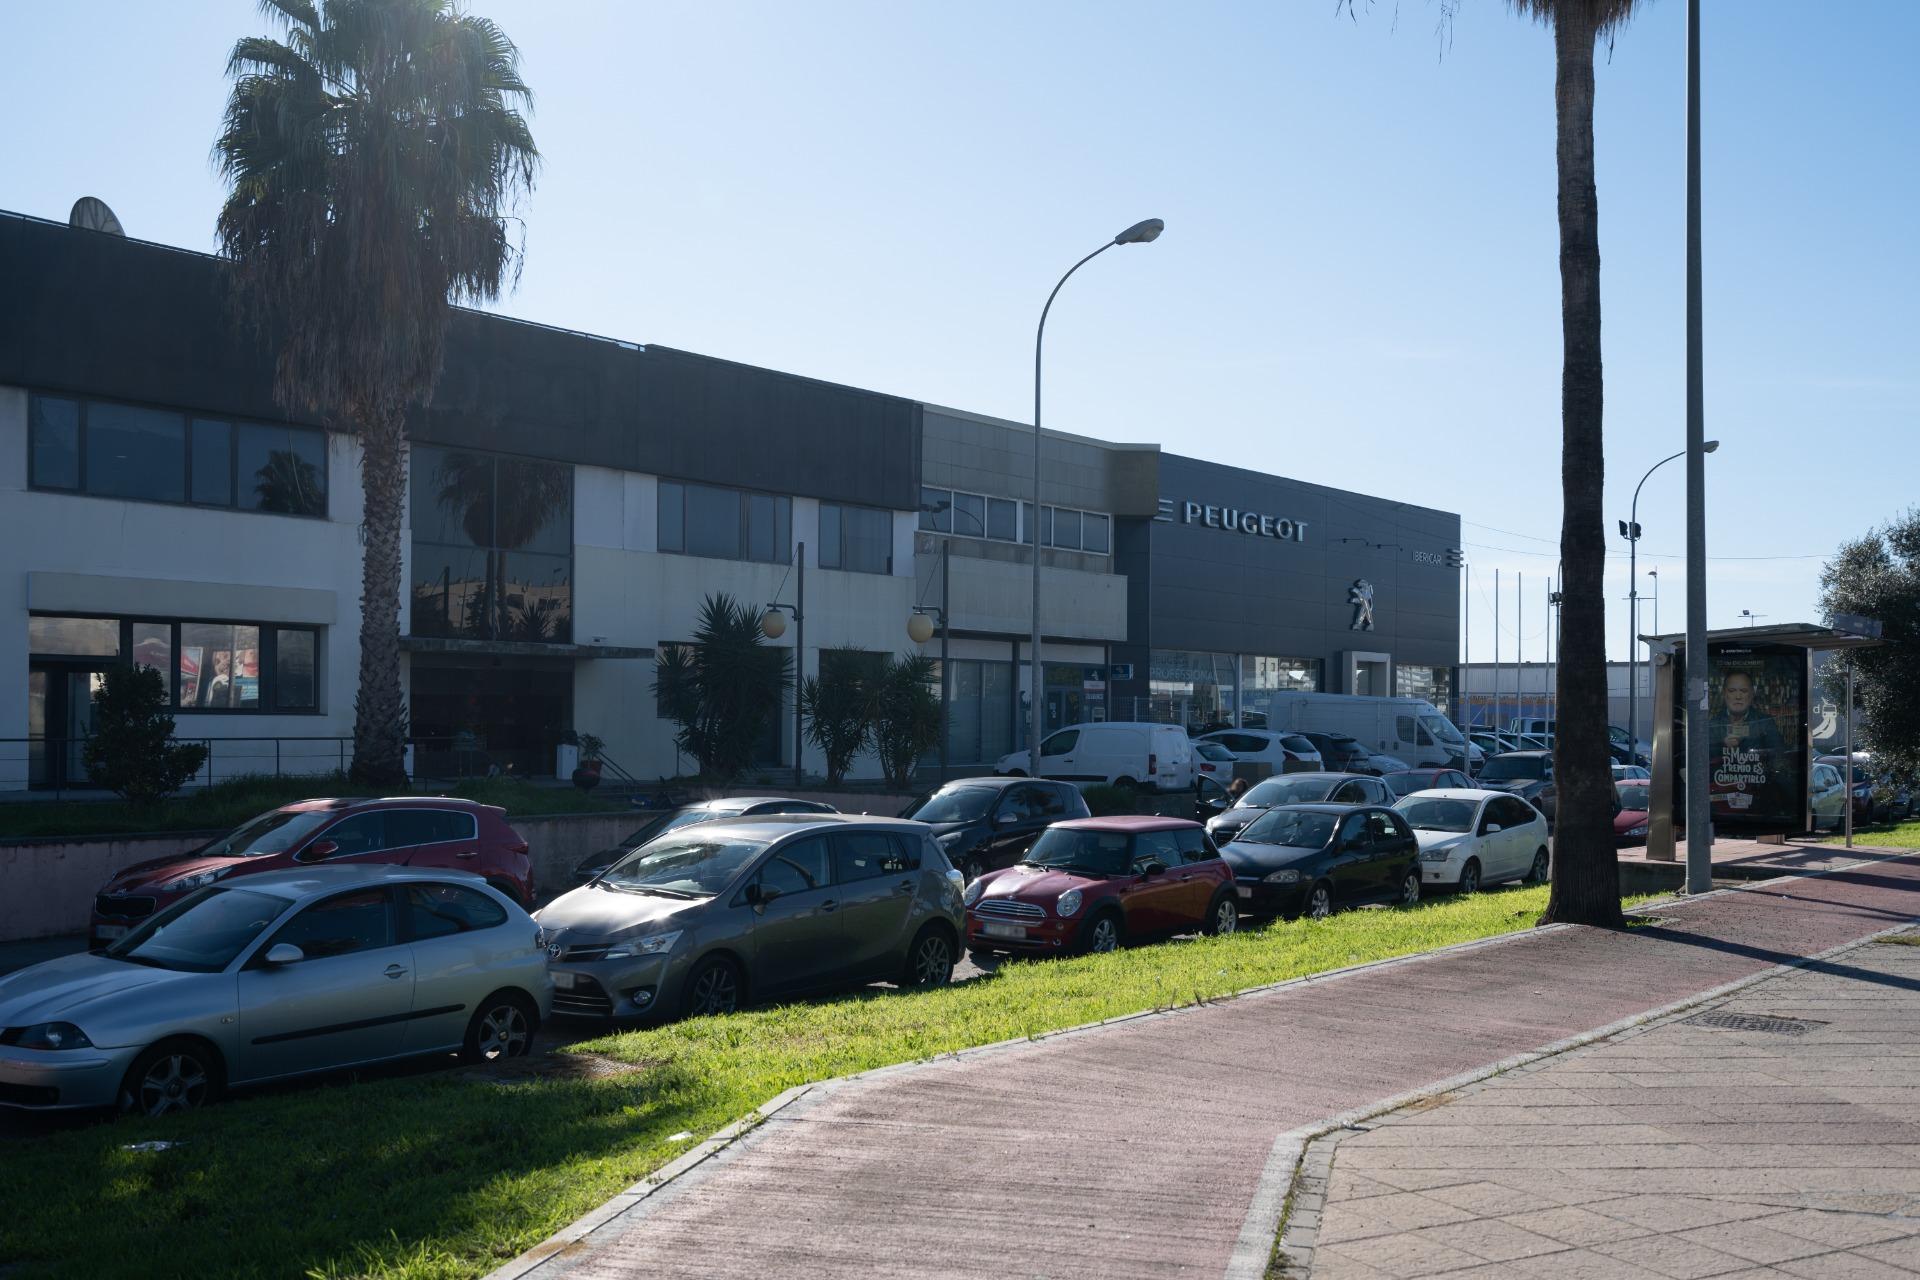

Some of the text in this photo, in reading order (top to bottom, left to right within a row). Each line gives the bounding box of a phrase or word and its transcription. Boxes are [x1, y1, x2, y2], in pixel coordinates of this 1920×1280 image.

[1182, 500, 1309, 542] PEUGEOT
[1722, 747, 1760, 764] EL MAYOR
[1722, 756, 1763, 775] PREMIO ES
[1714, 769, 1766, 790] COMPARTIRLO
